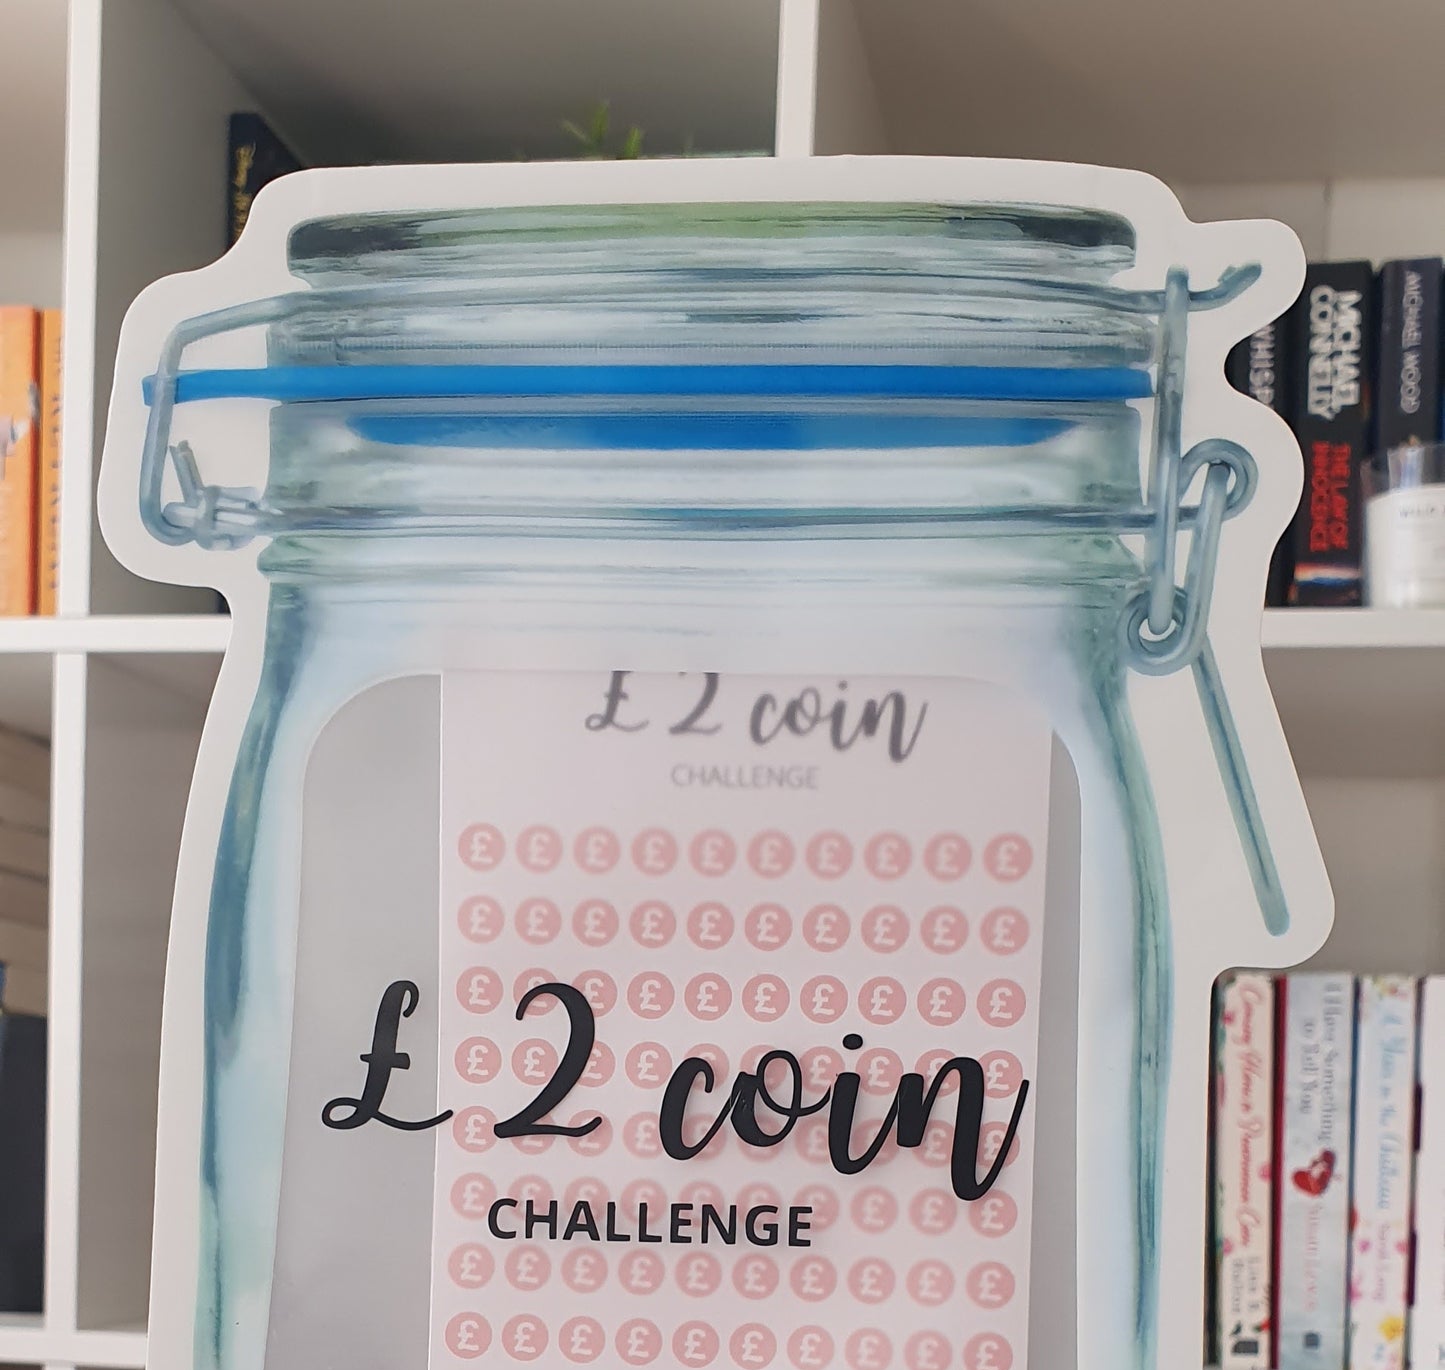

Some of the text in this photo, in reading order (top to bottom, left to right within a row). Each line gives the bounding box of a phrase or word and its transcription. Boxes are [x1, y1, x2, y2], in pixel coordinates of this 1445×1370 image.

[1308, 284, 1336, 422] CONNELLY
[1332, 290, 1363, 406] MICHAEL
[750, 679, 929, 764] coin
[671, 762, 821, 792] CHALLENGE
[659, 1032, 1031, 1202] coin
[487, 1198, 814, 1248] CHALLENGE
